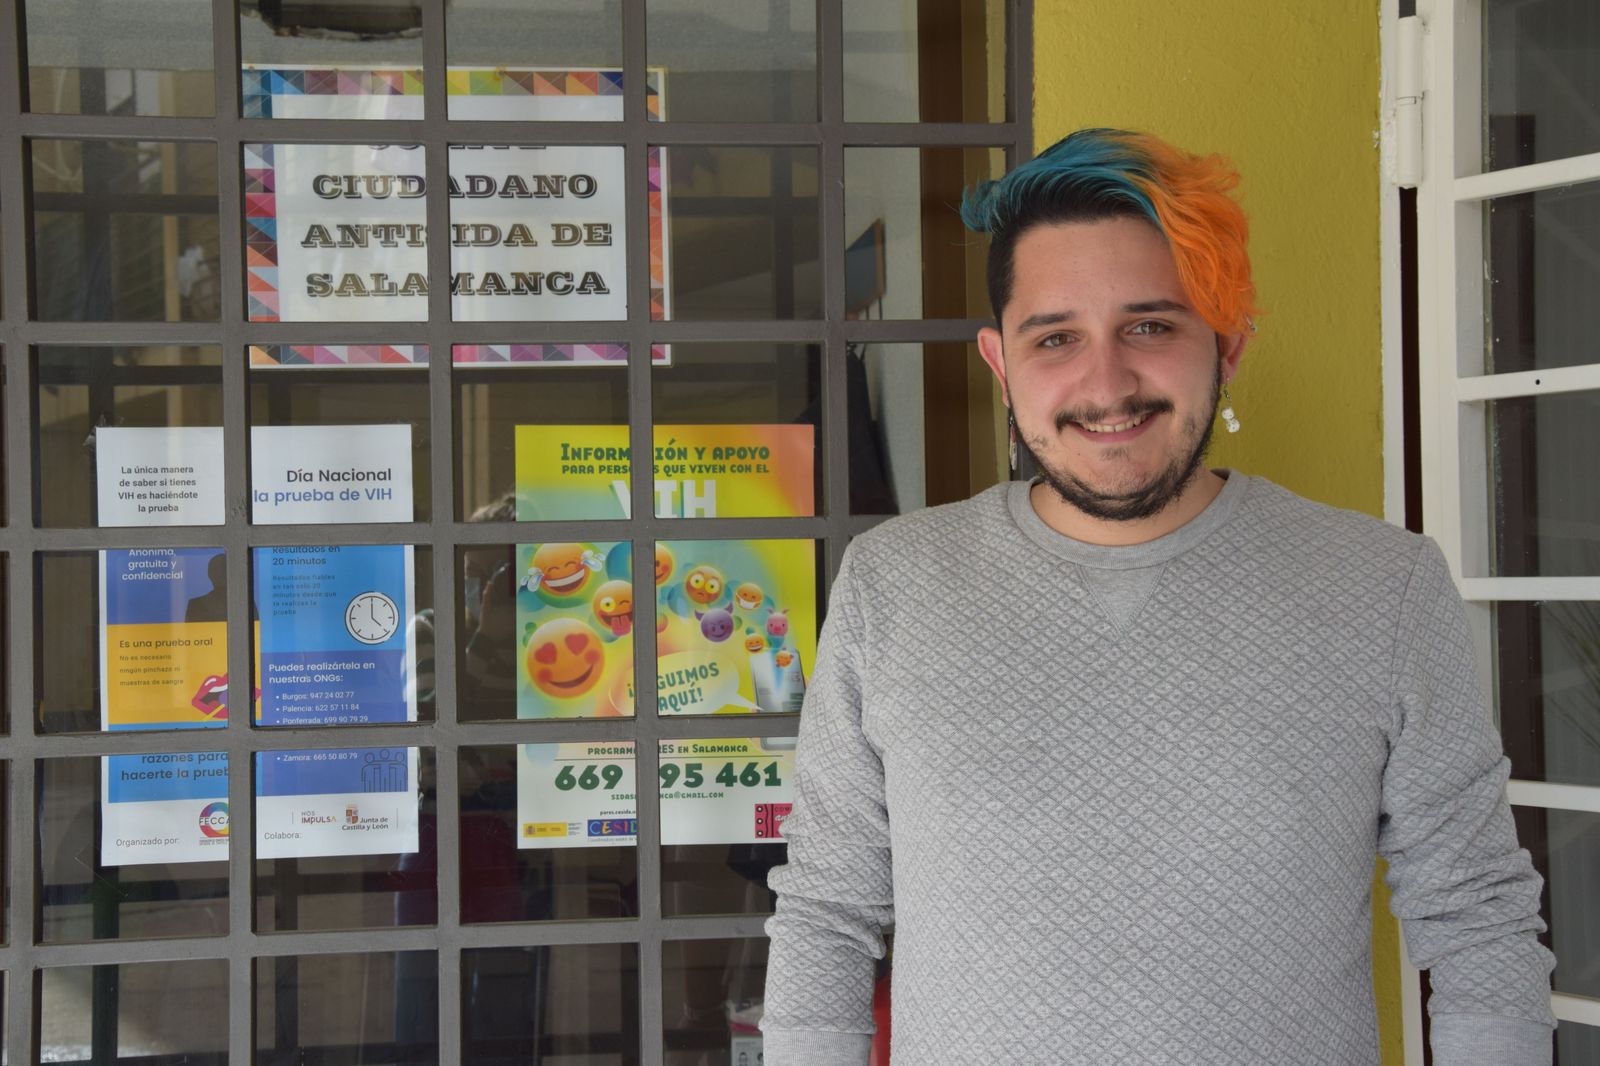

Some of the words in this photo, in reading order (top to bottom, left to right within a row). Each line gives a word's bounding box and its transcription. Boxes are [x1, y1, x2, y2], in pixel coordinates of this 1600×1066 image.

[301, 223, 538, 248] ANTIIDA
[550, 223, 612, 247] DE
[561, 438, 687, 461] INFORMIÓN
[694, 447, 705, 461] Y
[712, 446, 770, 460] APOYO
[121, 466, 132, 474] La
[134, 465, 158, 474] única
[161, 466, 194, 474] manera
[562, 465, 594, 475] PARA
[599, 464, 660, 474] PERSS
[664, 464, 686, 477] QUE
[689, 464, 726, 474] VIVEN
[730, 464, 752, 473] CON
[756, 464, 770, 473] EL
[287, 469, 313, 483] Día
[319, 468, 391, 482] Nacional
[119, 478, 130, 487] de
[132, 478, 157, 487] saber
[160, 478, 167, 486] si
[169, 477, 196, 486] tienes
[118, 491, 134, 500] VIH
[149, 490, 198, 500] haciéndote
[254, 490, 268, 502] la
[274, 489, 334, 506] prueba
[339, 488, 360, 501] de
[364, 488, 392, 500] VIH
[138, 504, 146, 512] la
[148, 504, 179, 514] prueba
[272, 546, 326, 554] Resultados
[128, 559, 168, 570] gratuita
[170, 560, 177, 570] y
[272, 557, 284, 566] 20
[287, 557, 327, 565] minutos
[121, 571, 183, 581] confidencial
[119, 640, 130, 648] Es
[133, 640, 152, 648] una
[155, 639, 191, 649] prueba
[194, 637, 213, 646] oral
[269, 663, 304, 672] Puedes
[307, 661, 360, 672] realizártela
[269, 675, 311, 684] nuestras
[314, 674, 343, 683] ONGs:
[658, 681, 704, 712] AQUÍ!
[588, 747, 636, 755] PROGRAM
[692, 744, 748, 753] SALAMANCA
[142, 753, 193, 764] razones
[197, 752, 229, 764] para
[283, 754, 312, 762] Zamora:
[121, 769, 172, 781] hacerte
[177, 768, 189, 778] la
[193, 767, 229, 780] prueb
[555, 764, 623, 791] 669
[658, 762, 704, 788] 95
[715, 762, 782, 787] 461
[264, 832, 302, 840] Colabora:
[116, 838, 162, 848] Organizado
